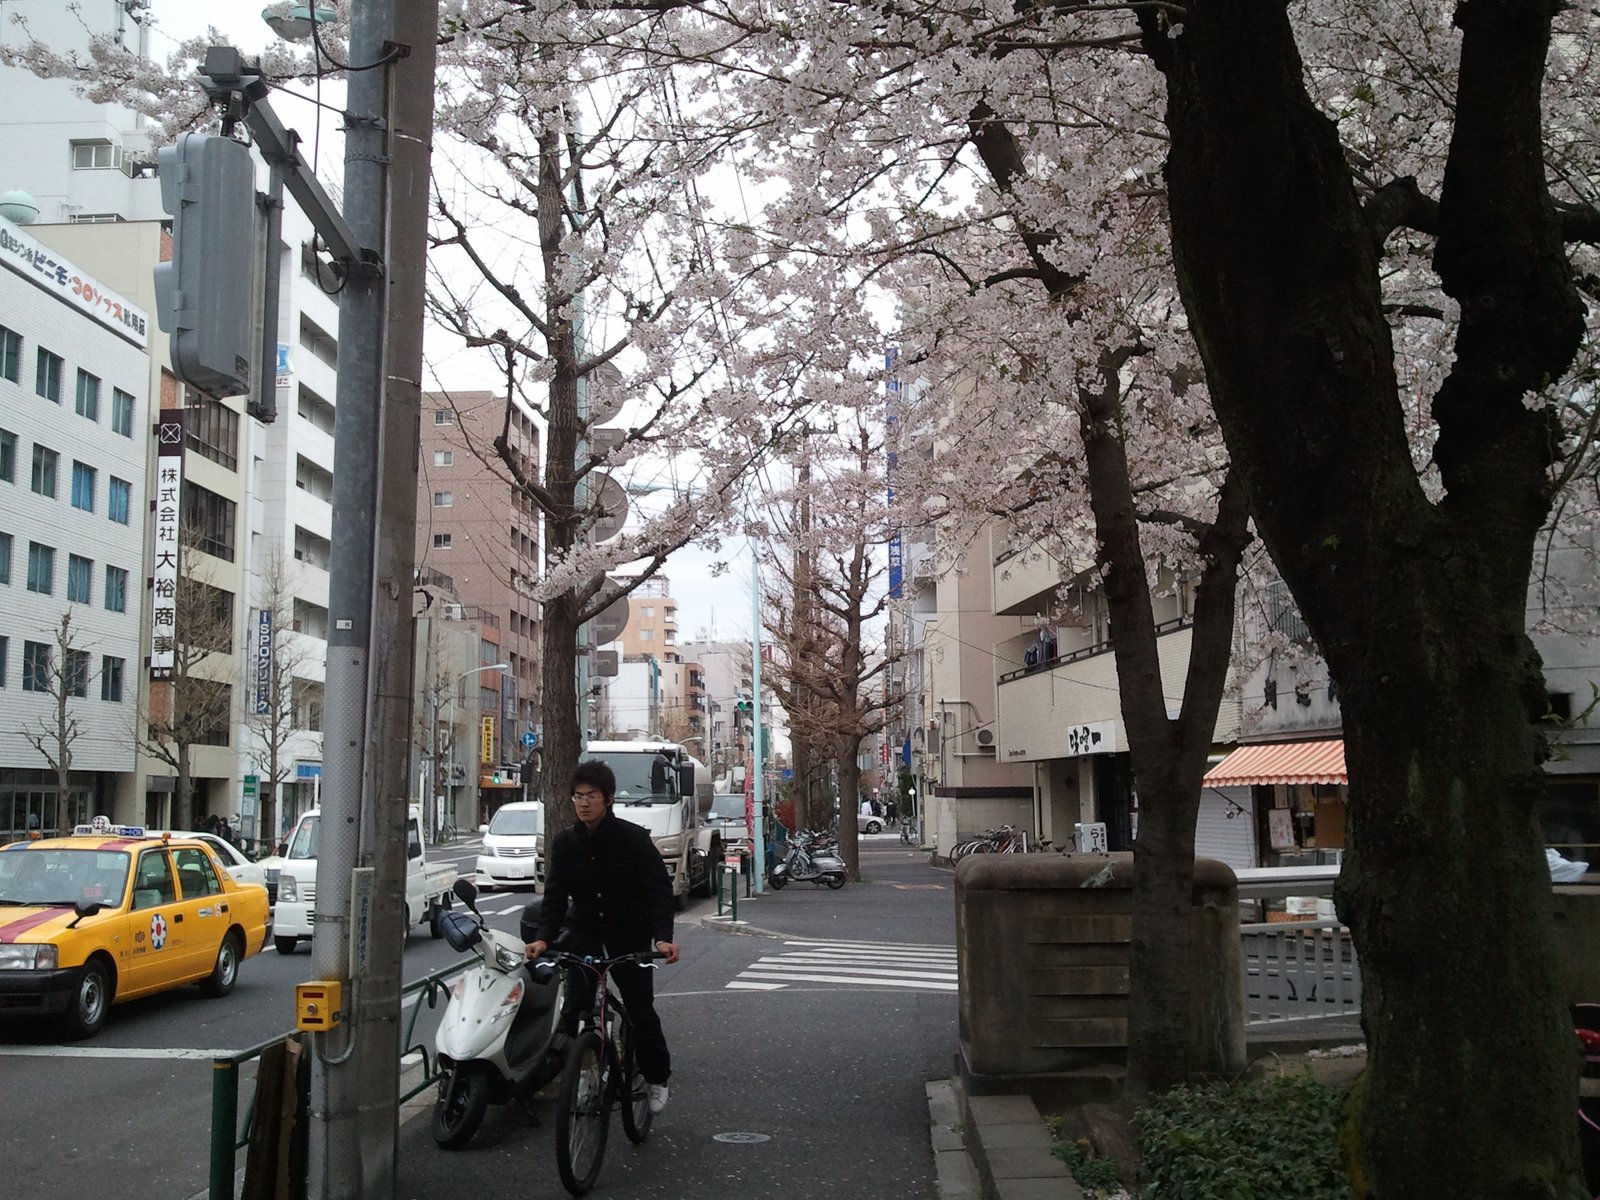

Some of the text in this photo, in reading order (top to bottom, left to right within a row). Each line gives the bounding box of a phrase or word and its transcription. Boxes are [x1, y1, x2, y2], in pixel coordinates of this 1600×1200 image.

[153, 467, 178, 656] 株式会社大裕商事
